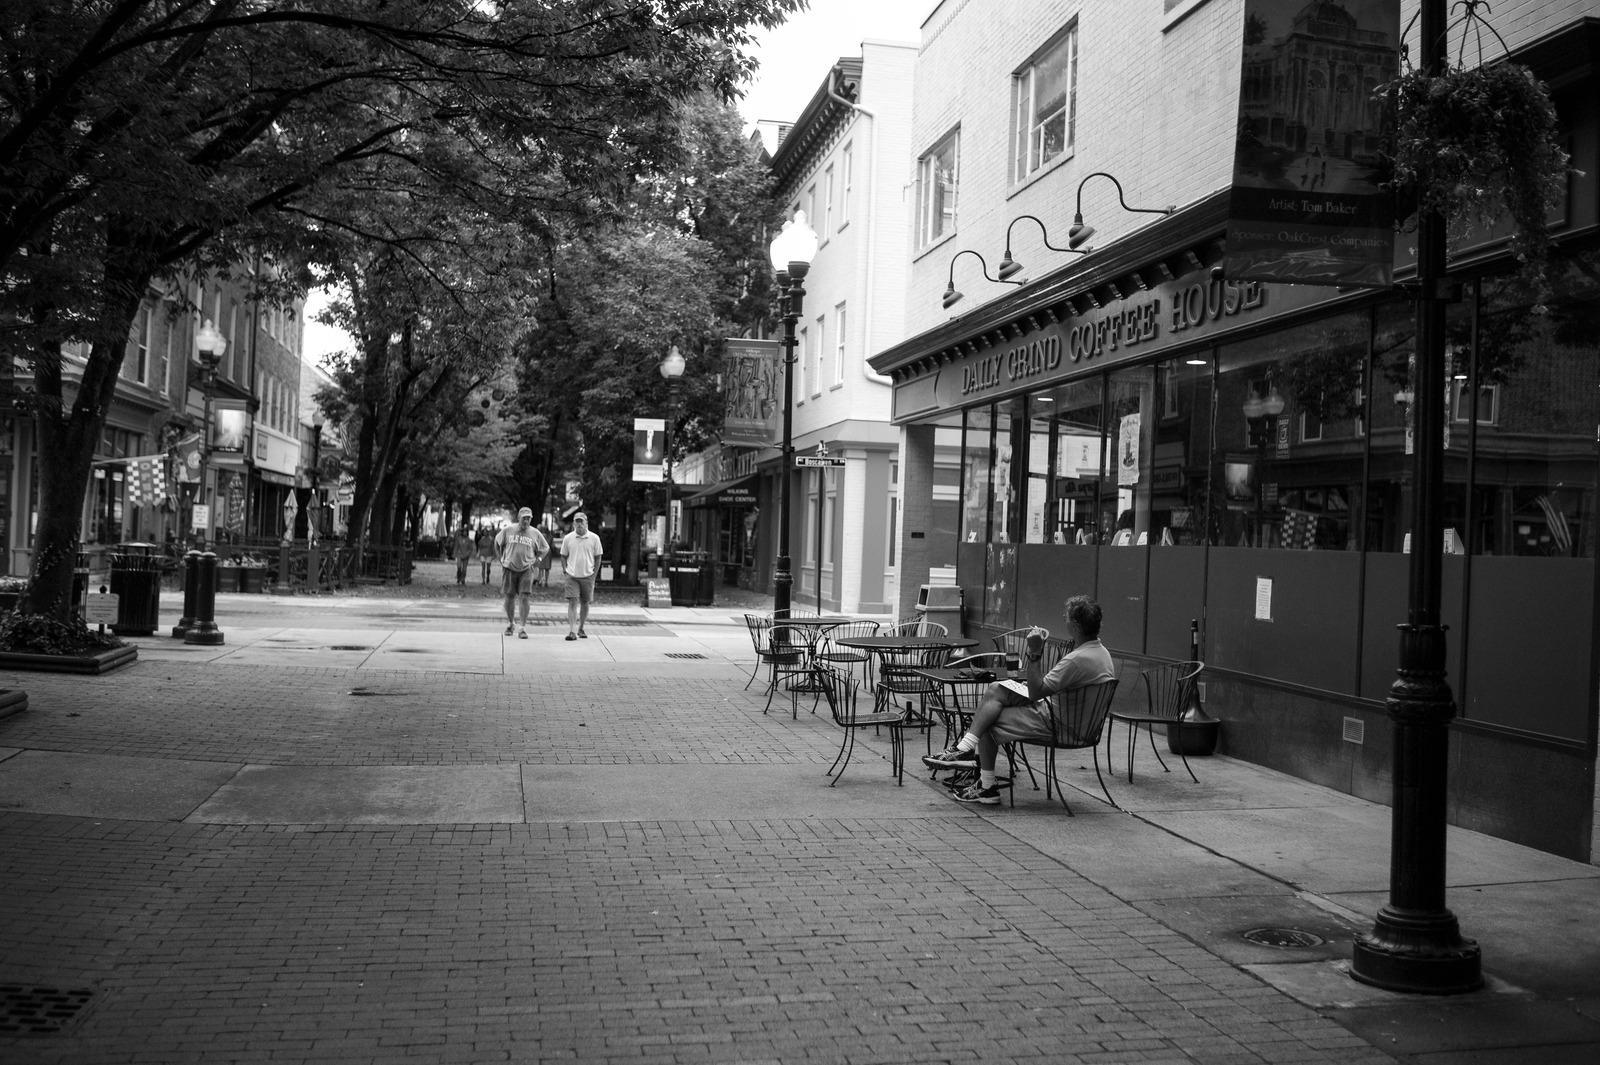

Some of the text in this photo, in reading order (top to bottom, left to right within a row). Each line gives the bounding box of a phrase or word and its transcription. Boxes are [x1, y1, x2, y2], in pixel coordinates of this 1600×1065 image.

[1268, 197, 1358, 214] Artist: Tom Baker
[1231, 228, 1274, 242] Sponsor:
[1277, 231, 1328, 244] OakCrest
[960, 279, 1264, 395] DAILY GRIND COFFEE HOUSE
[508, 534, 533, 547] OLE MISS
